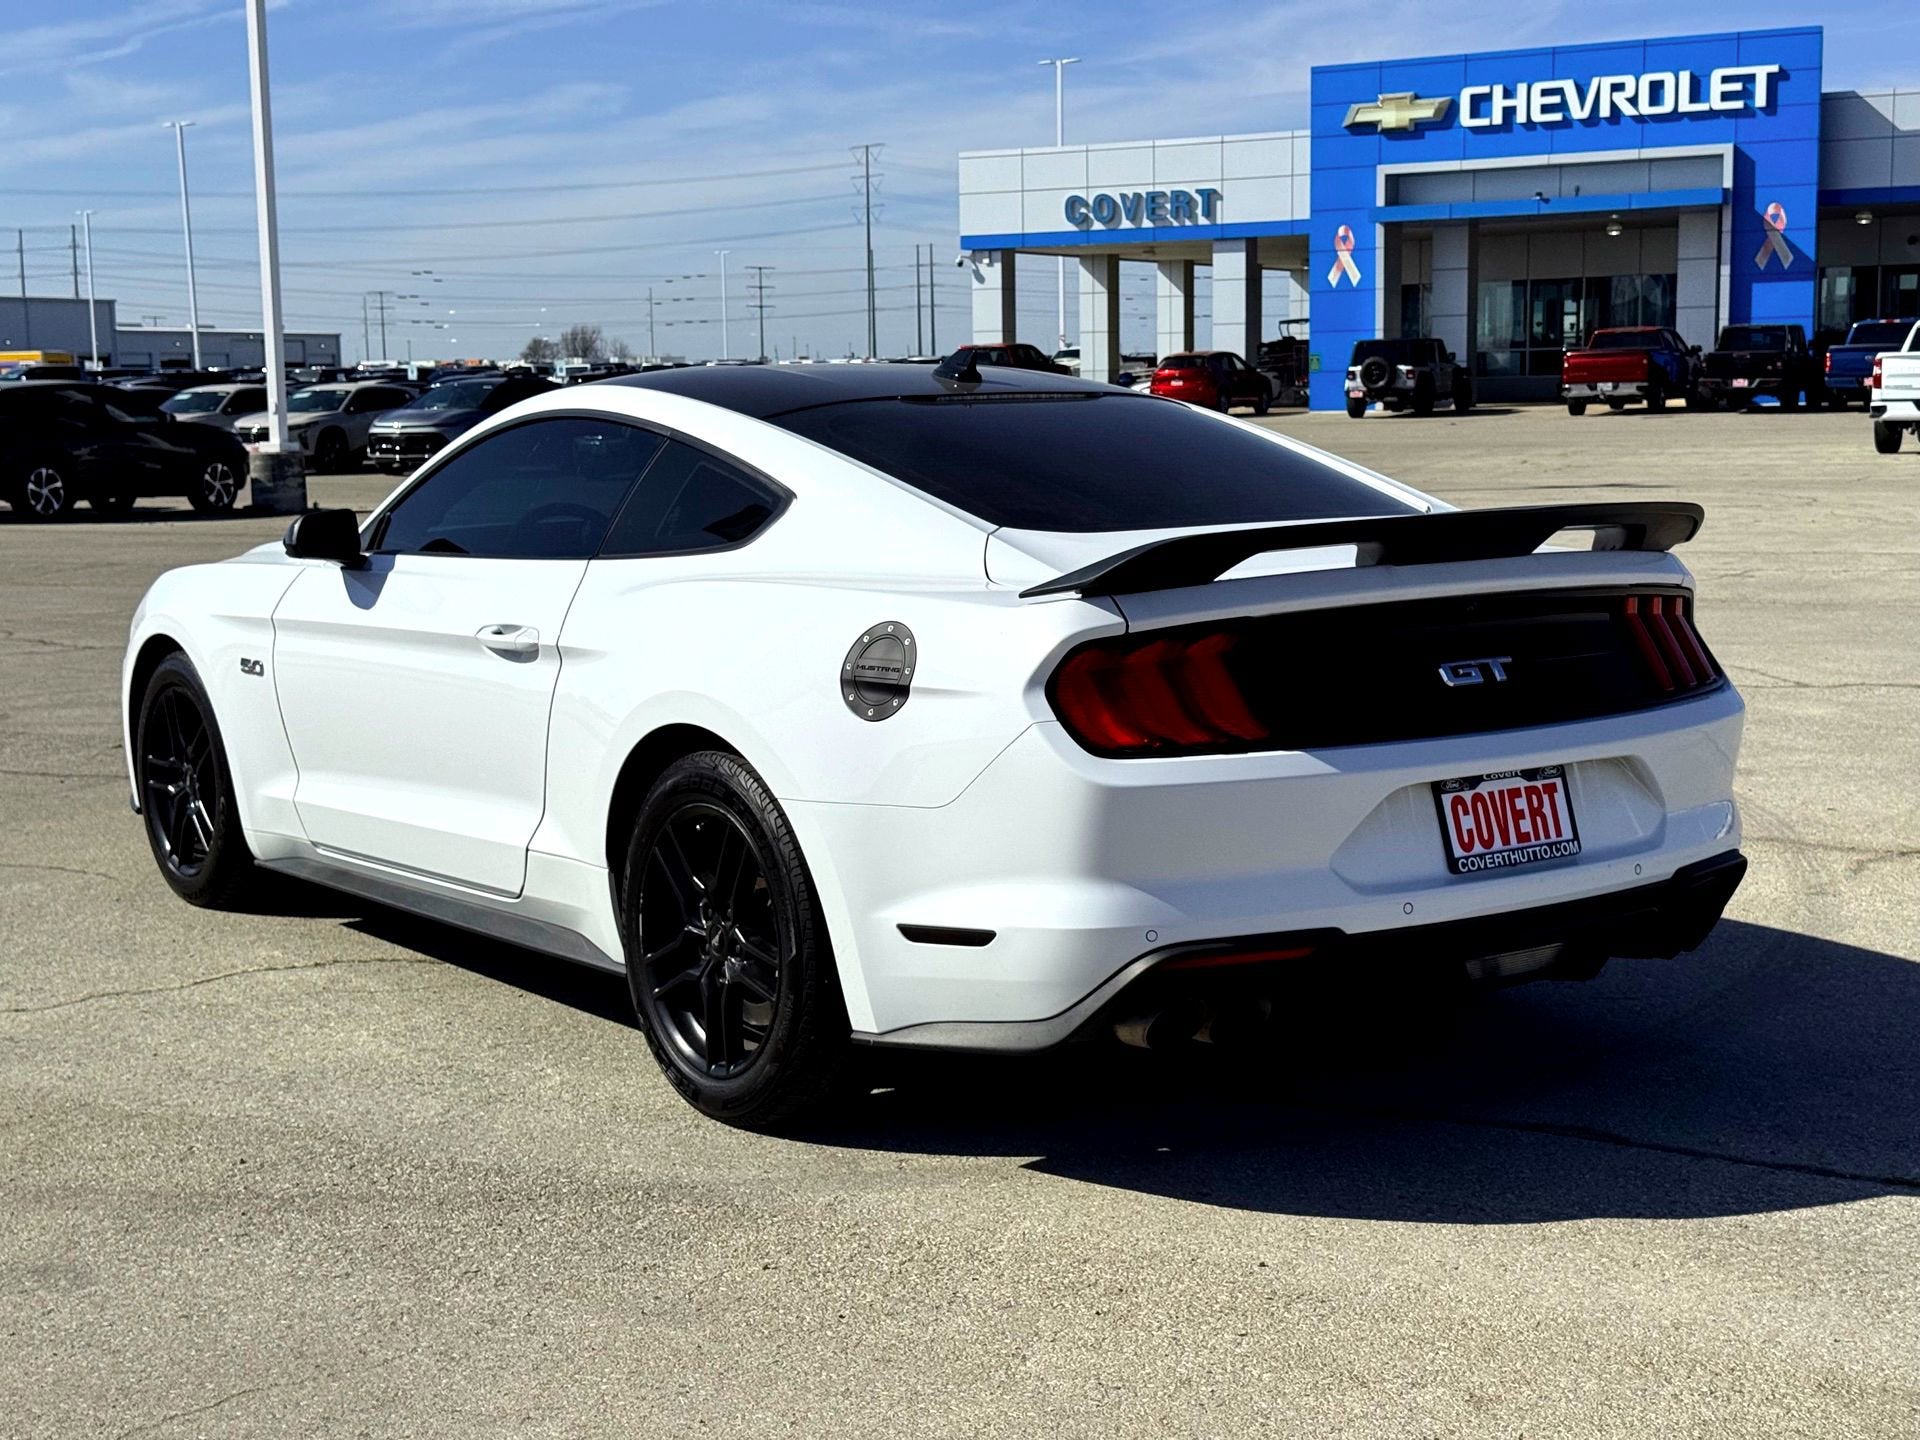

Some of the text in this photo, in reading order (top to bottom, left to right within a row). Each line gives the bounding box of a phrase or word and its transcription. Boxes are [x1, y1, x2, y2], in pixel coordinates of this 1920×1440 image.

[1459, 64, 1780, 128] CHEVROLET
[1065, 188, 1217, 228] COVERT
[856, 664, 901, 673] MUSTANG
[1438, 655, 1513, 688] GT
[1482, 769, 1522, 781] Covert
[1450, 782, 1563, 853] COVERT
[1458, 840, 1580, 873] COVERTHUTTO.COM
